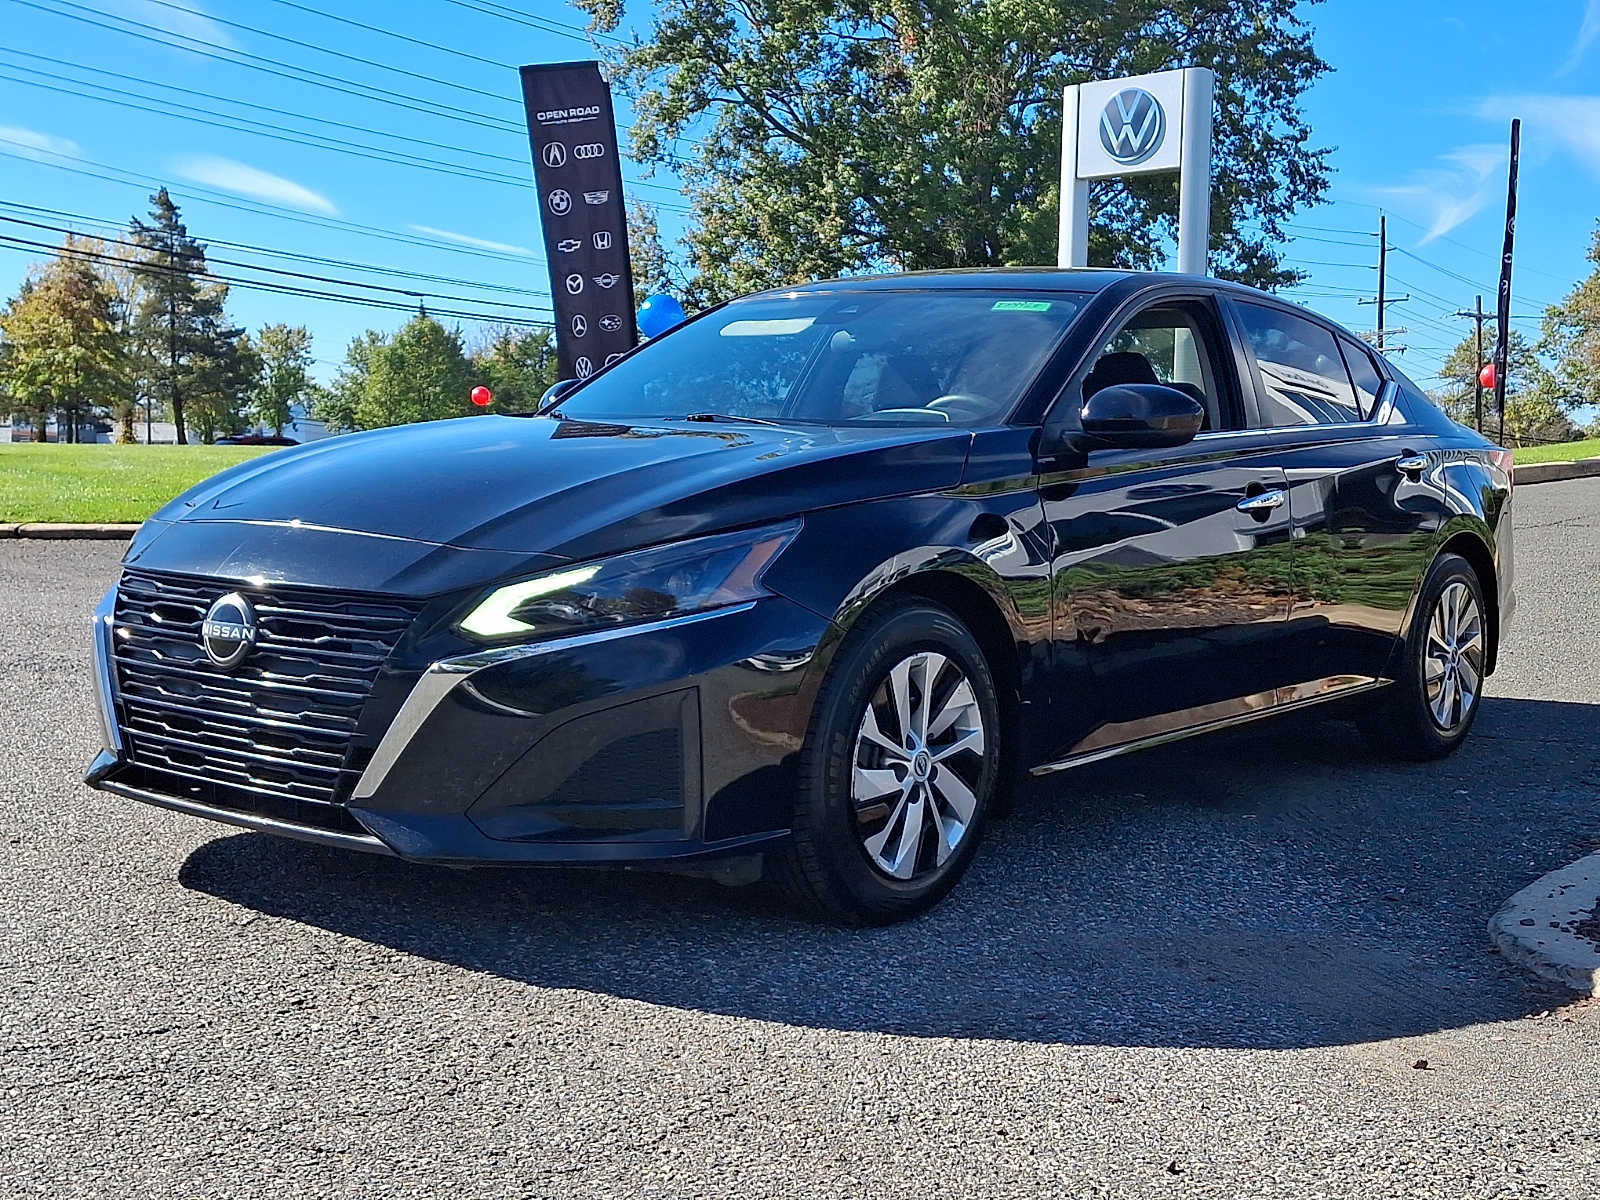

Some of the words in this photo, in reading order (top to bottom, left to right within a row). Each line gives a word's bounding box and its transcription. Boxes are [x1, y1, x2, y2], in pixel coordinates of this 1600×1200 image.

[537, 109, 568, 121] OPEN
[569, 105, 600, 117] ROAD
[202, 621, 254, 641] NISSAN
